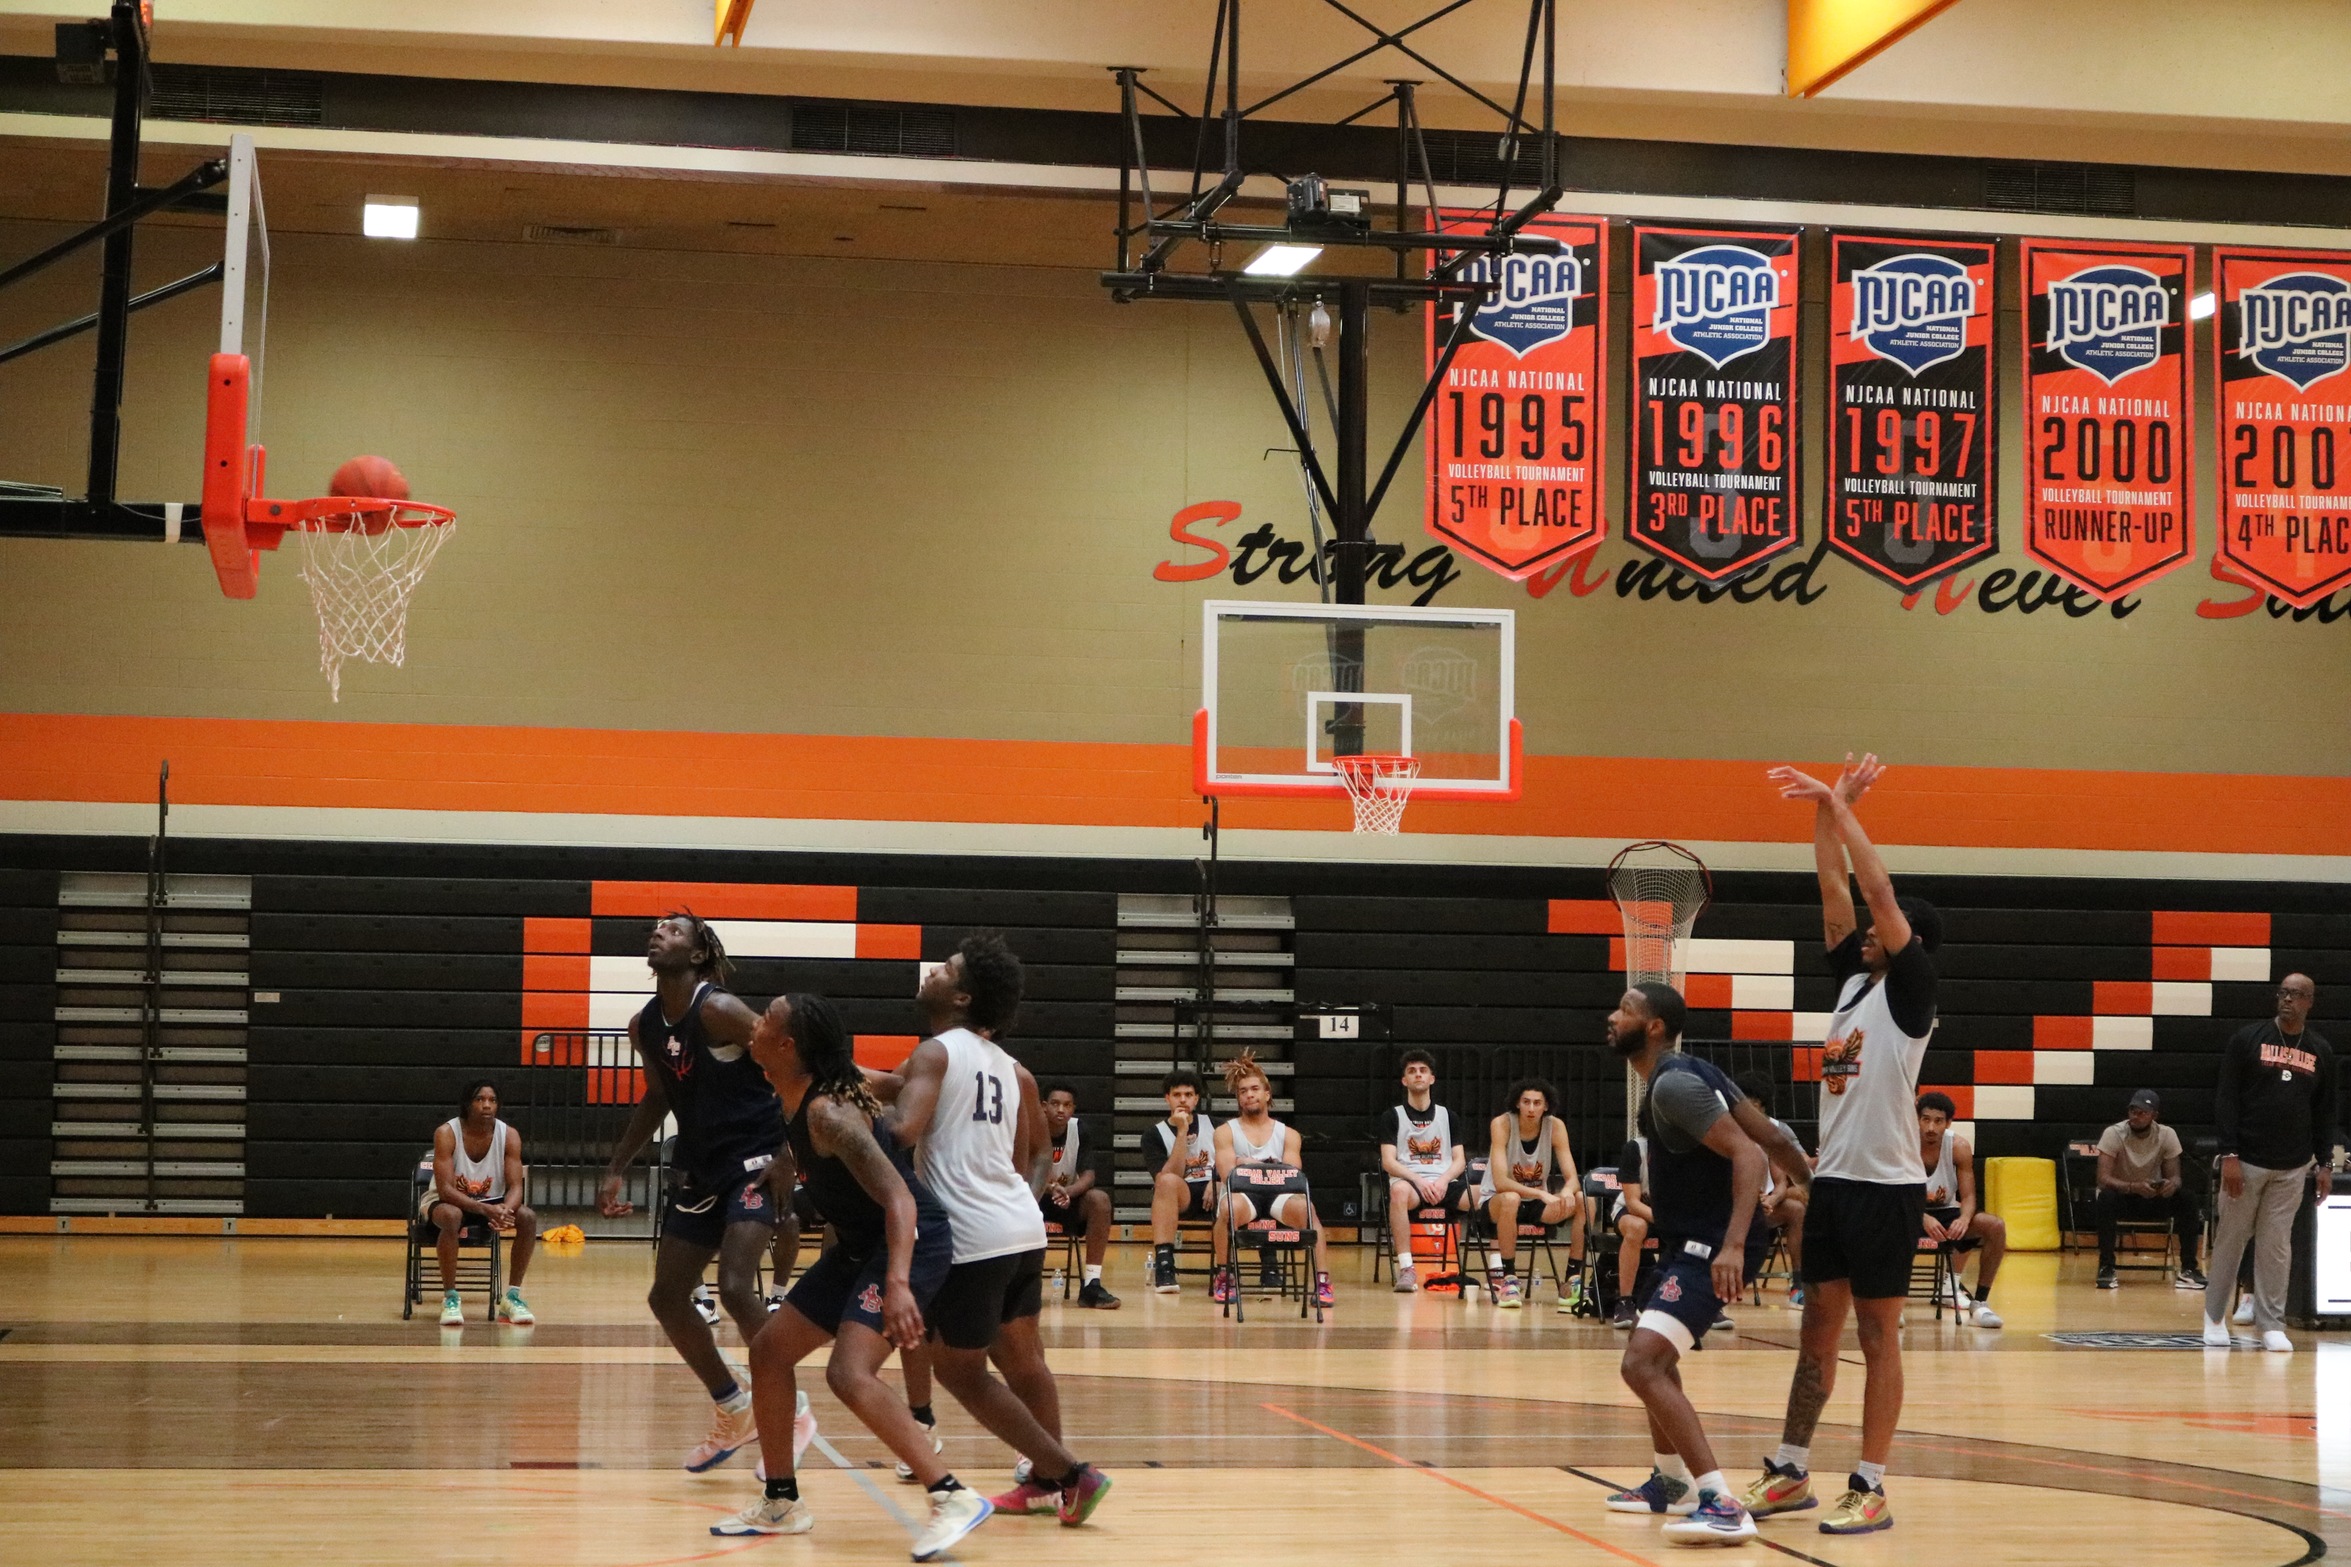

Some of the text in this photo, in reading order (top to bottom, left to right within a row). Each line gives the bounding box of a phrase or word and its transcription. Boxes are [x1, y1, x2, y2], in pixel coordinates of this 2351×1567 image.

[1657, 266, 1775, 324] NJCAA
[1855, 274, 1971, 333] NJCAA
[1510, 313, 1566, 322] JUNIOR COLLEGE
[1531, 306, 1566, 314] NATIONAL
[2051, 285, 2166, 344] NJCAA
[1494, 321, 1566, 330] ATHLETIC ASSOCIATION
[1729, 316, 1764, 325] NATIONAL
[1735, 325, 1764, 333] COLLEGE
[1926, 325, 1960, 333] NATIONAL
[2243, 292, 2351, 350] NJCAA
[1692, 331, 1764, 341] ATHLETIC ASSOCIATION
[1889, 339, 1960, 349] ATHLETIC ASSOCIATION
[1931, 333, 1960, 341] COLLEGE
[2085, 349, 2154, 358] ATHLETIC ASSOCIATION
[1450, 368, 1585, 391] NJCAA NATIONAL
[1649, 377, 1782, 401] NJCAA NATIONAL
[1846, 384, 1976, 409] NJCAA NATIONAL
[2042, 395, 2170, 418] NJCAA NATIONAL
[2236, 401, 2283, 421] NJCAA
[1449, 391, 1585, 461] 1995
[1648, 400, 1782, 471] 1996
[1846, 407, 1976, 478] 1997
[2043, 416, 2171, 484] 2000
[2235, 424, 2351, 490] 200
[1448, 463, 1585, 482] VOLLEYBALL TOURNAMENT
[1649, 471, 1782, 491] VOLLEYBALL TOURNAMENT
[1845, 477, 1977, 498] VOLLEYBALL TOURNAMENT
[2042, 487, 2173, 506] VOLLEYBALL TOURNAMENT
[1451, 484, 1583, 528] 5TH PLACE
[2235, 493, 2296, 508] VOLLEYBALL
[1650, 492, 1782, 536] 3RD PLACE
[1846, 498, 1976, 543] 5TH PLACE
[2045, 508, 2173, 543] RUNNER-UP
[1330, 1016, 1350, 1032] 14
[972, 1070, 1003, 1125] 13
[1236, 1168, 1299, 1178] CEDAR VALLEY
[1250, 1177, 1286, 1185] COLLEGE
[1268, 1231, 1300, 1242] SUNS
